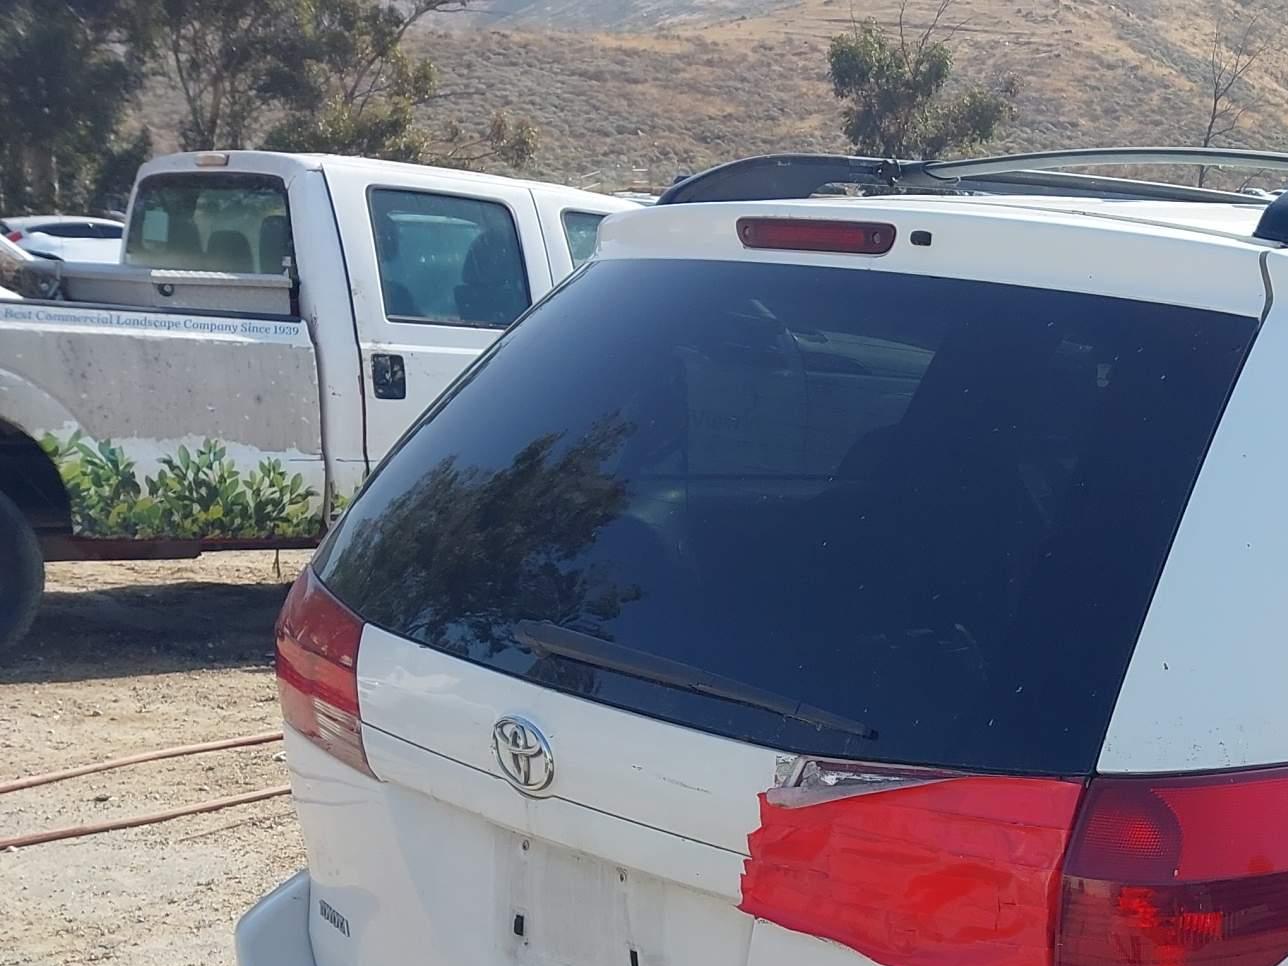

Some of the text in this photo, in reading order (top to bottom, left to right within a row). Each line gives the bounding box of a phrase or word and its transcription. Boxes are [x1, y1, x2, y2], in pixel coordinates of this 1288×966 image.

[4, 307, 300, 336] Best Commercial Landscape Company Since 1939
[319, 899, 351, 938] TOYOTA
